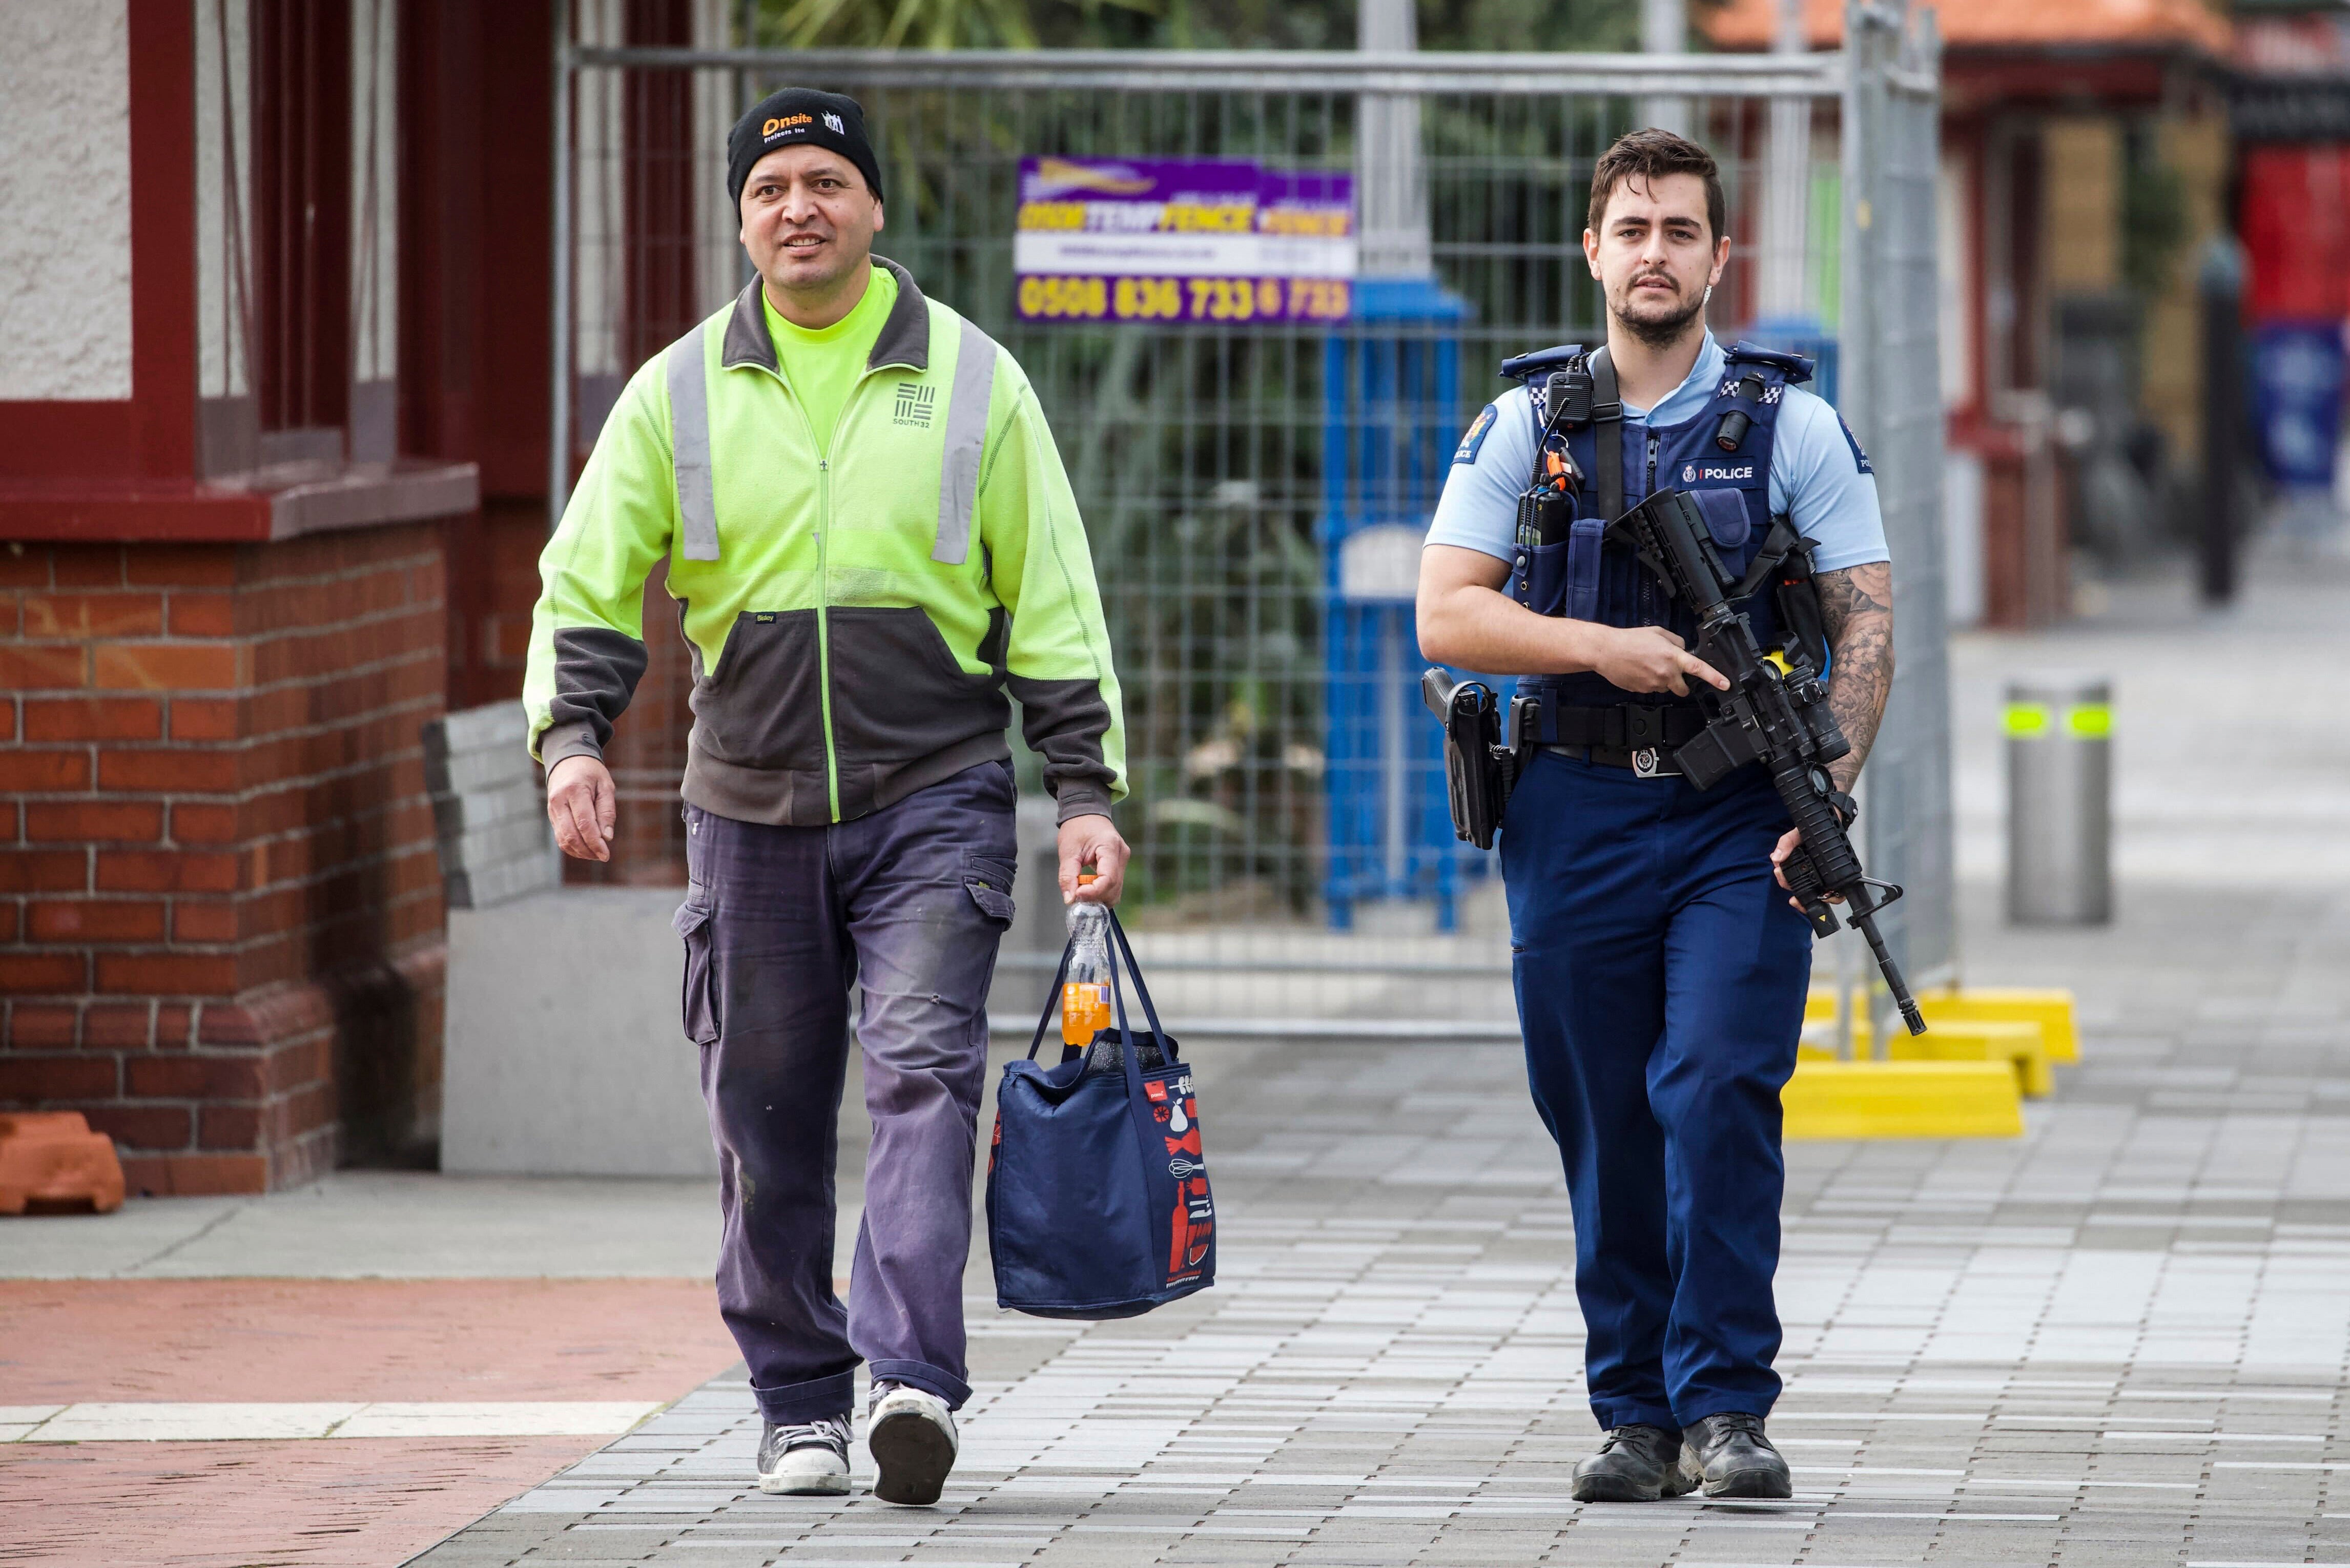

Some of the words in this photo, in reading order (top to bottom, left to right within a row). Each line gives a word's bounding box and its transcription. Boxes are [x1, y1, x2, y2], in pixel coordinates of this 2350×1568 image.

[762, 113, 812, 136] Onsite
[1019, 277, 1107, 317] 0508
[1114, 278, 1181, 319] 836
[1187, 278, 1254, 320] 733
[1455, 450, 1472, 459] LICE
[1705, 467, 1753, 479] POLICE
